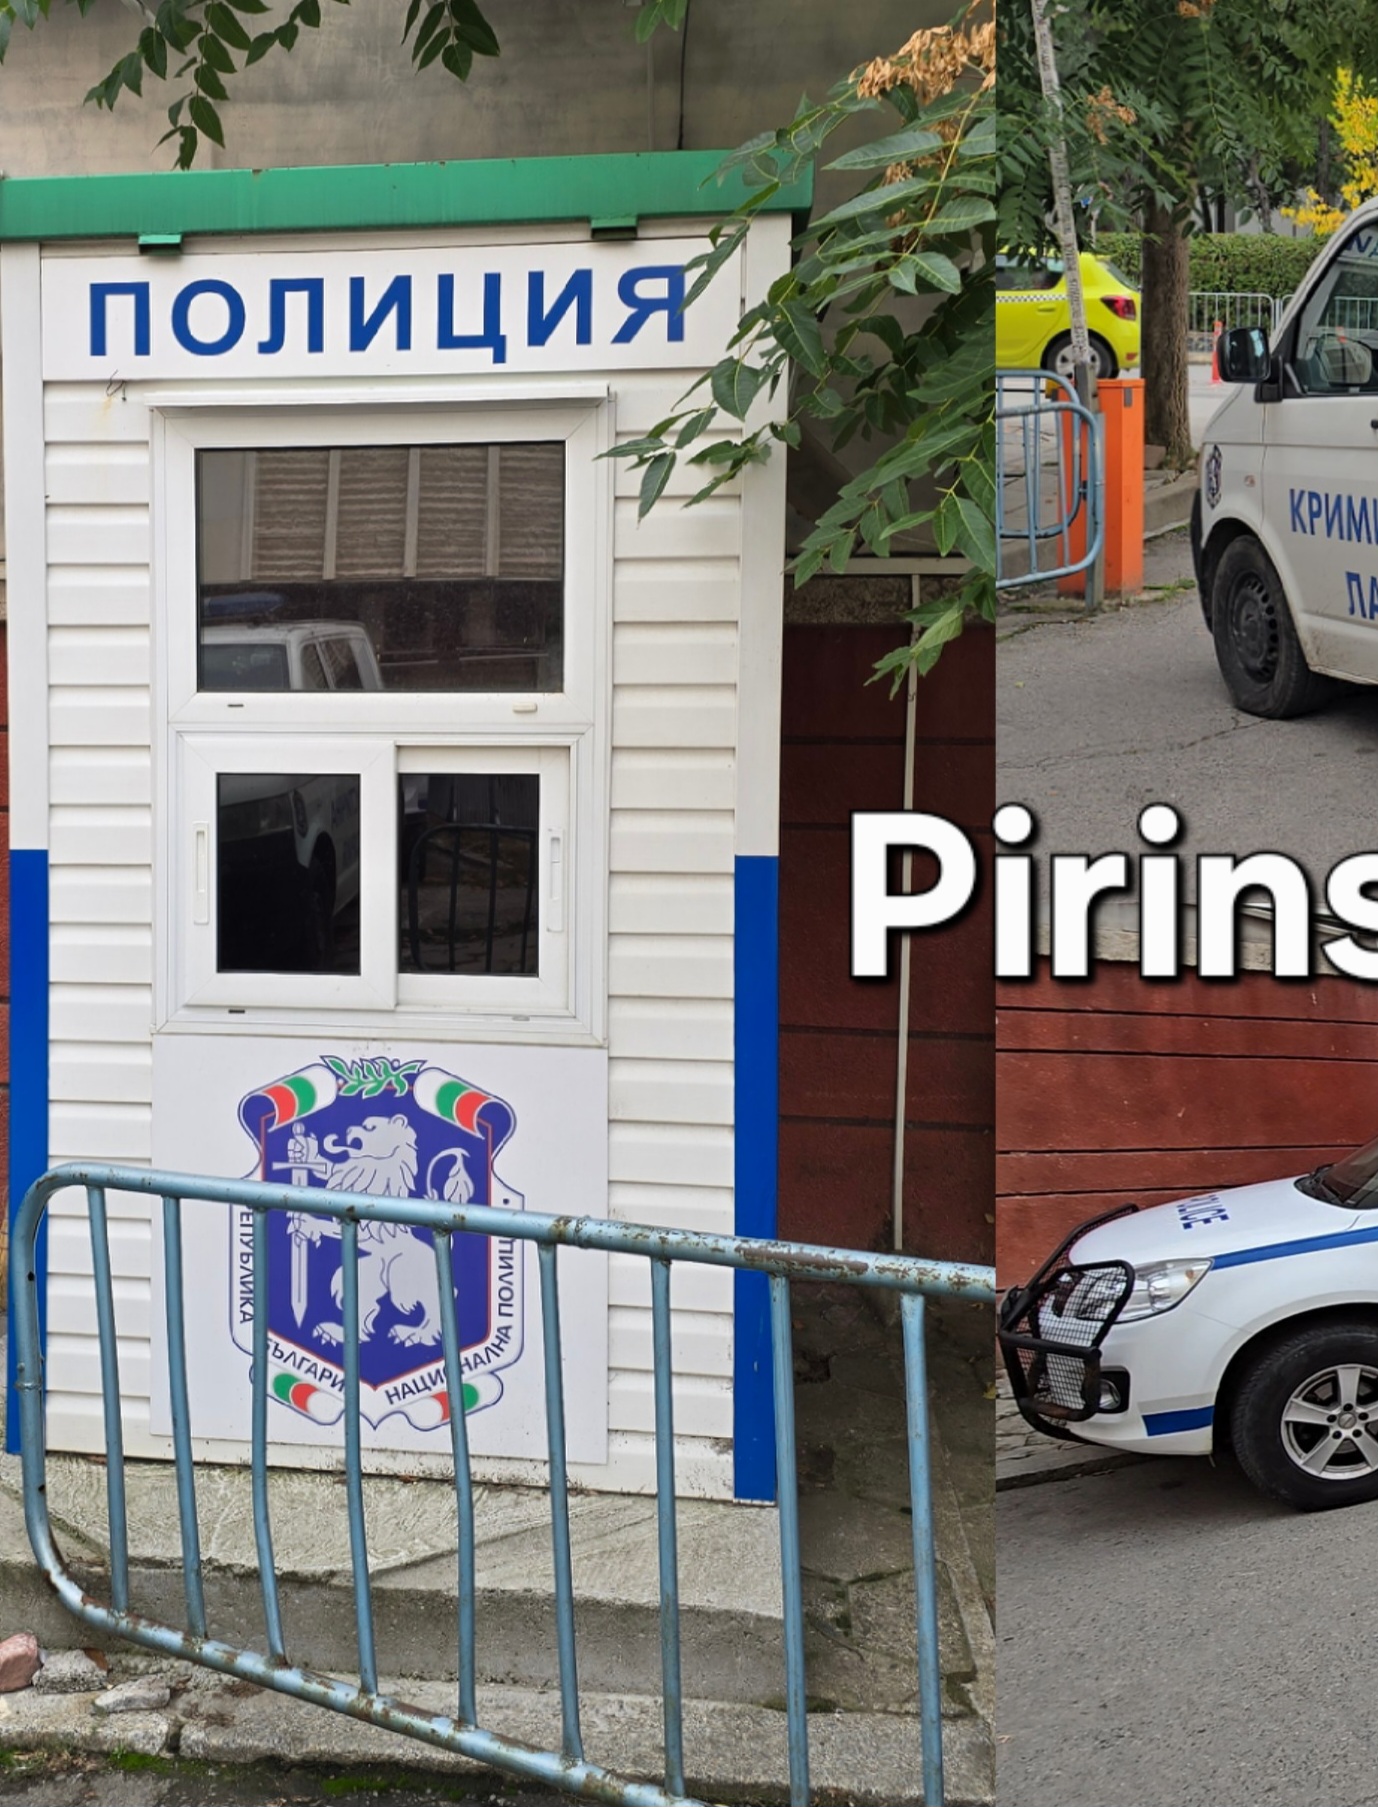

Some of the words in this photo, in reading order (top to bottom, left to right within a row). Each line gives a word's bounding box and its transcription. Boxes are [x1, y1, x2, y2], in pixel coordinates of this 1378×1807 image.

[88, 264, 686, 365] ПОЛИЦИЯ
[240, 1205, 255, 1324] ЕПУБЛИКА
[267, 1338, 345, 1393] ЪЛГАРИ
[384, 1324, 513, 1405] НАЦИНАЛНА
[498, 1238, 516, 1317] ПОЛИЦ
